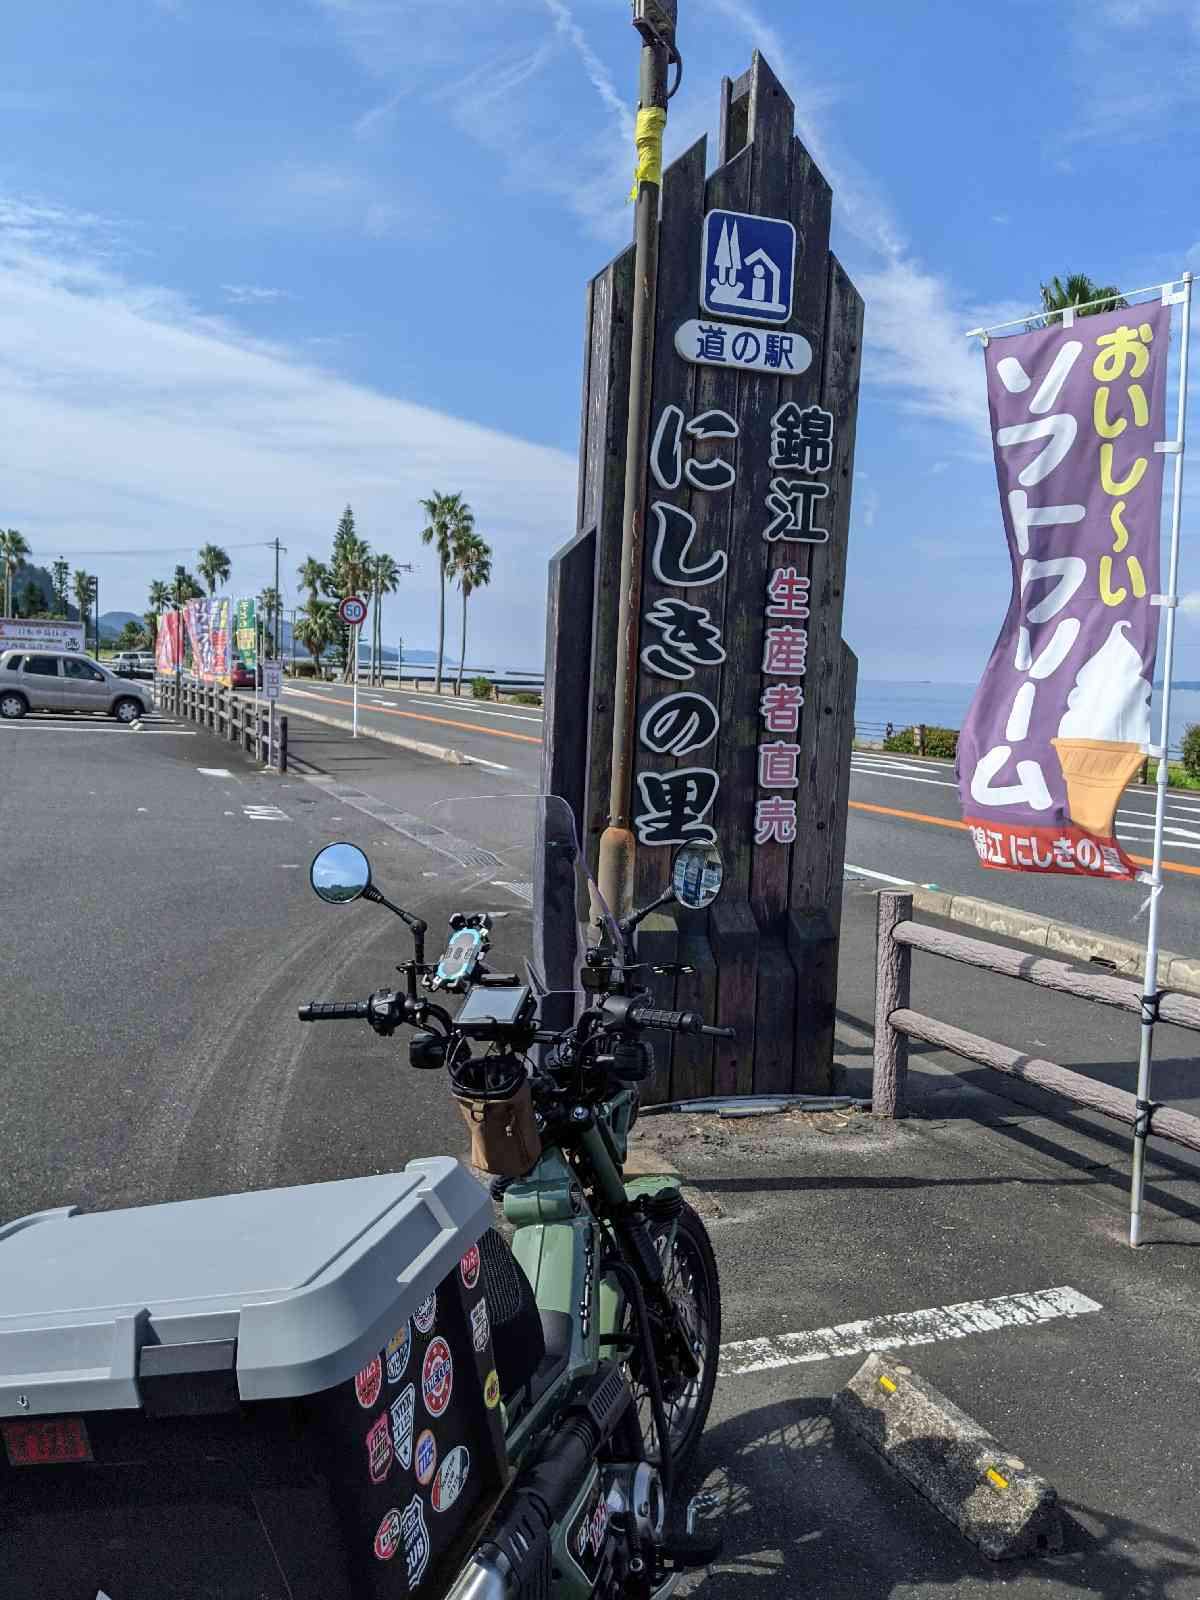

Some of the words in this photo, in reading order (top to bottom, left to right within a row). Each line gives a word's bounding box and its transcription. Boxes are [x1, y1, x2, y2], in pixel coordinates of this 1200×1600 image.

[696, 323, 794, 370] 道の駅
[762, 401, 834, 544] 錦江
[970, 340, 1087, 811] ソフトクリーム
[346, 604, 361, 617] 50
[635, 404, 740, 846] にしきの里
[755, 566, 811, 846] 生産者直売
